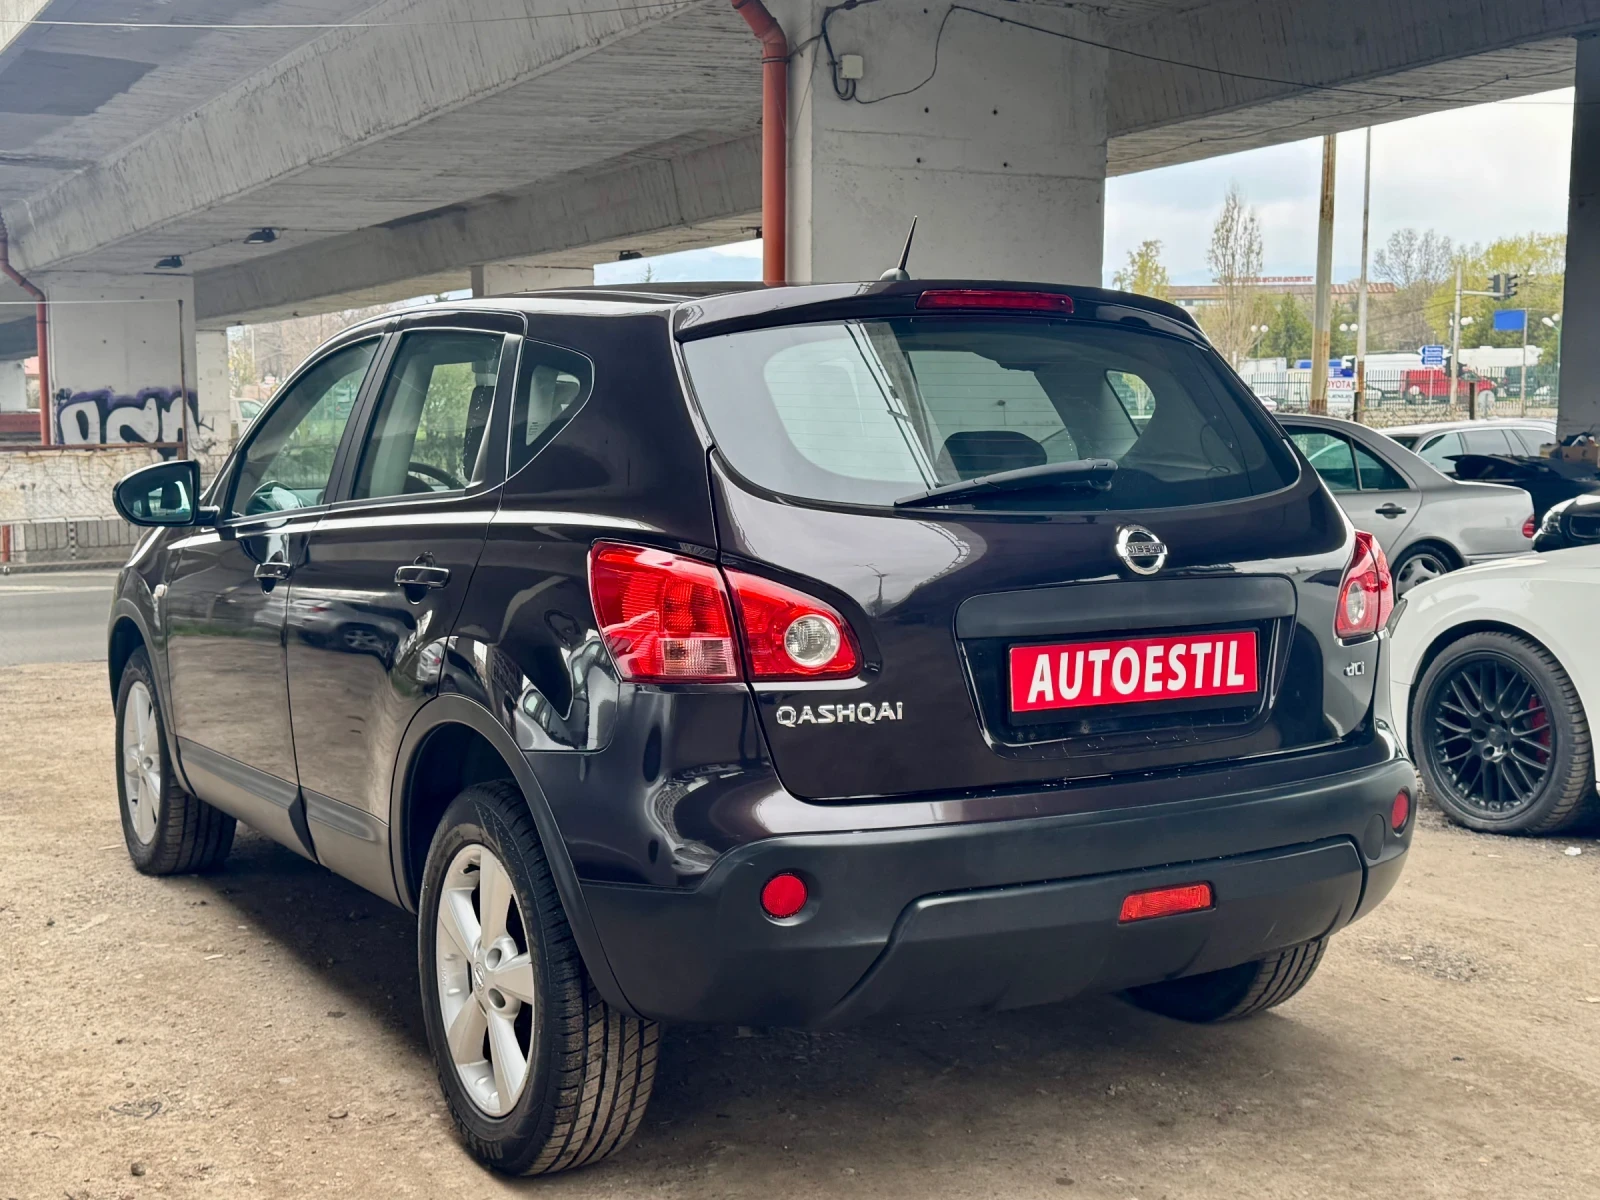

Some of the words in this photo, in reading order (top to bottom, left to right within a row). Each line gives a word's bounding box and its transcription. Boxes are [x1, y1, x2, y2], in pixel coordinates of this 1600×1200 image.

[1326, 380, 1352, 388] OYOTA
[1126, 544, 1165, 555] NISSAN
[1027, 640, 1245, 703] AUTOESTIL
[776, 701, 904, 728] QASHQAI
